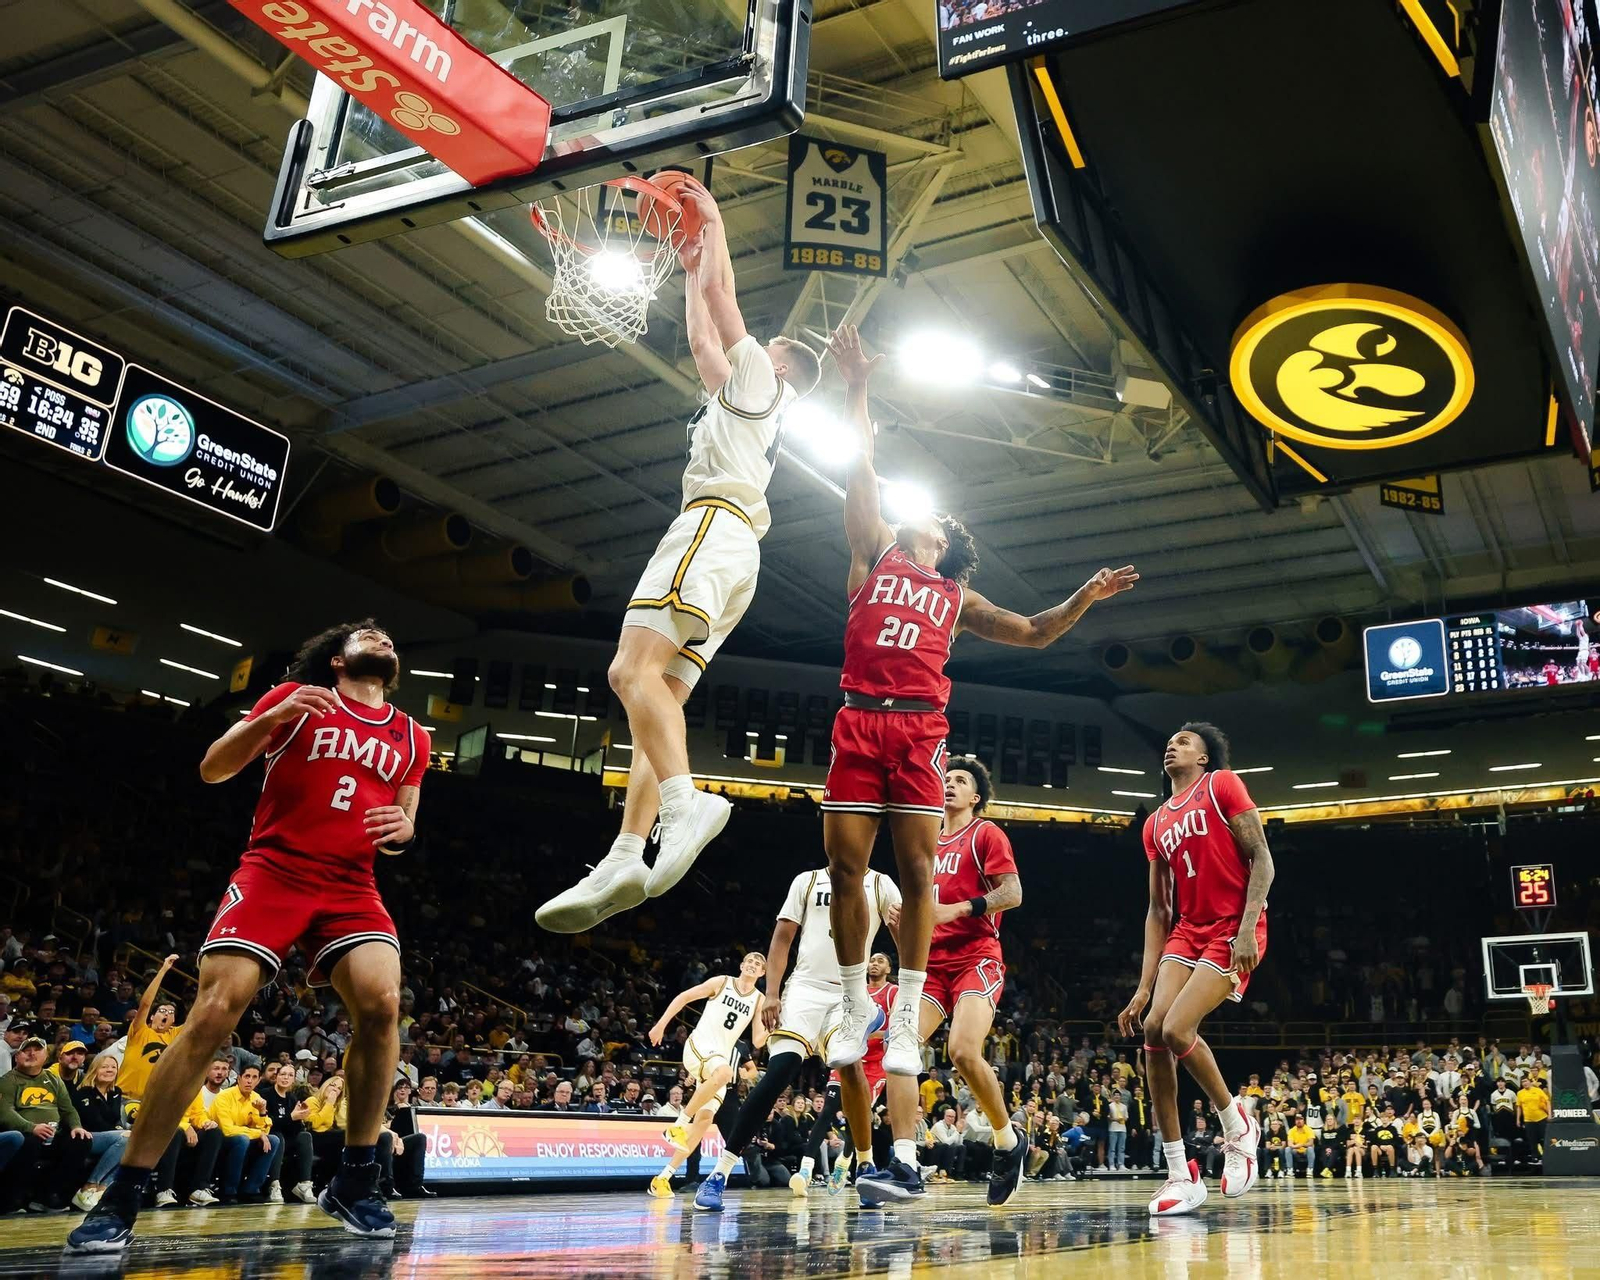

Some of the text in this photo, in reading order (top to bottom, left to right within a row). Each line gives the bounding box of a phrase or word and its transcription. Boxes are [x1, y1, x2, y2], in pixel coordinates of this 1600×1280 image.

[952, 23, 1006, 46] FAN WORK
[262, 1, 401, 92] State
[812, 177, 863, 194] MARBLE
[804, 191, 871, 236] 23
[791, 248, 881, 271] 1986-89
[0, 380, 21, 405] 59
[44, 388, 67, 407] POSS
[27, 394, 75, 430] 16:24
[34, 421, 57, 440] 2ND
[79, 417, 100, 439] 35
[197, 434, 277, 481] GreenState
[196, 450, 272, 490] CREDIT UNION
[184, 467, 267, 509] Go Hawks!
[1383, 488, 1441, 510] 1982-85
[867, 574, 952, 628] RMU
[1460, 617, 1480, 625] IOWA
[875, 615, 921, 651] 20
[1380, 667, 1434, 681] GreenState
[306, 726, 402, 782] RMU
[330, 775, 357, 812] 2
[1160, 808, 1208, 860] RMU
[1182, 850, 1197, 878] 1
[1519, 869, 1550, 882] 16:24
[1520, 882, 1549, 904] 25
[722, 994, 751, 1017] IOWA
[723, 1011, 738, 1031] 8
[537, 1143, 575, 1158] ENJOY
[579, 1143, 650, 1158] RESPONSIBLY
[451, 1158, 481, 1168] VODKA
